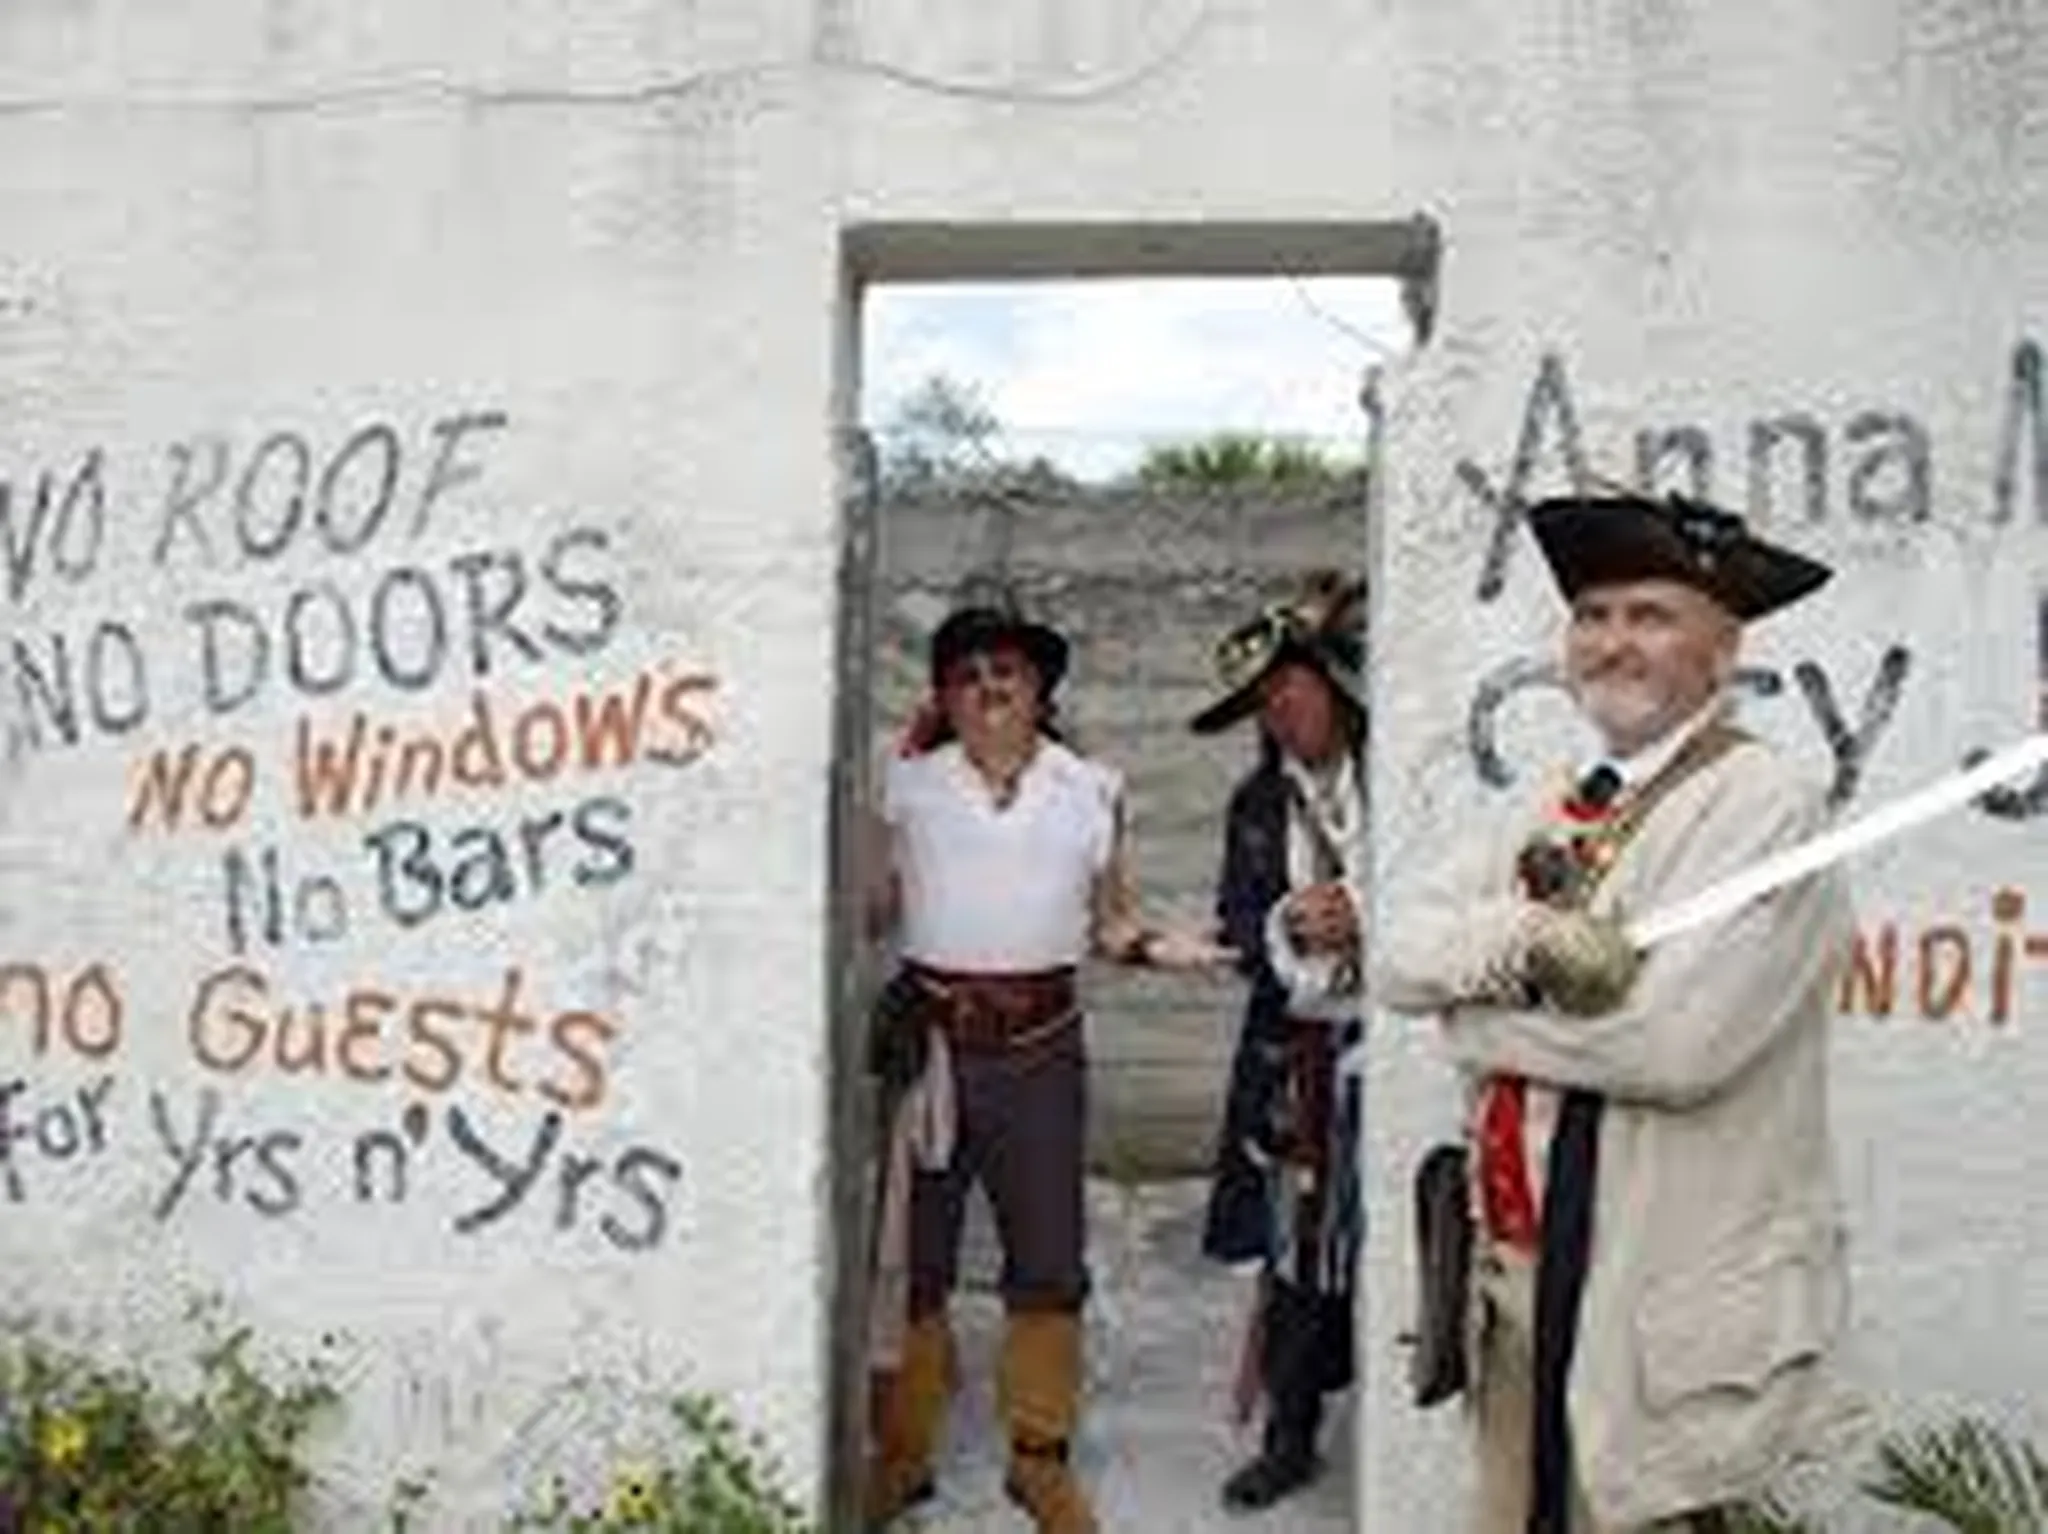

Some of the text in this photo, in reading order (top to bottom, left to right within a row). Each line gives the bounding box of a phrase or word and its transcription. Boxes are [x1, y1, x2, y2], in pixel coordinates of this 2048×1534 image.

[0, 410, 507, 602] NO ROOF
[1455, 352, 1932, 601] Anna
[5, 526, 628, 765] NO DOORS
[128, 743, 256, 830] NO
[364, 797, 637, 926] Bars
